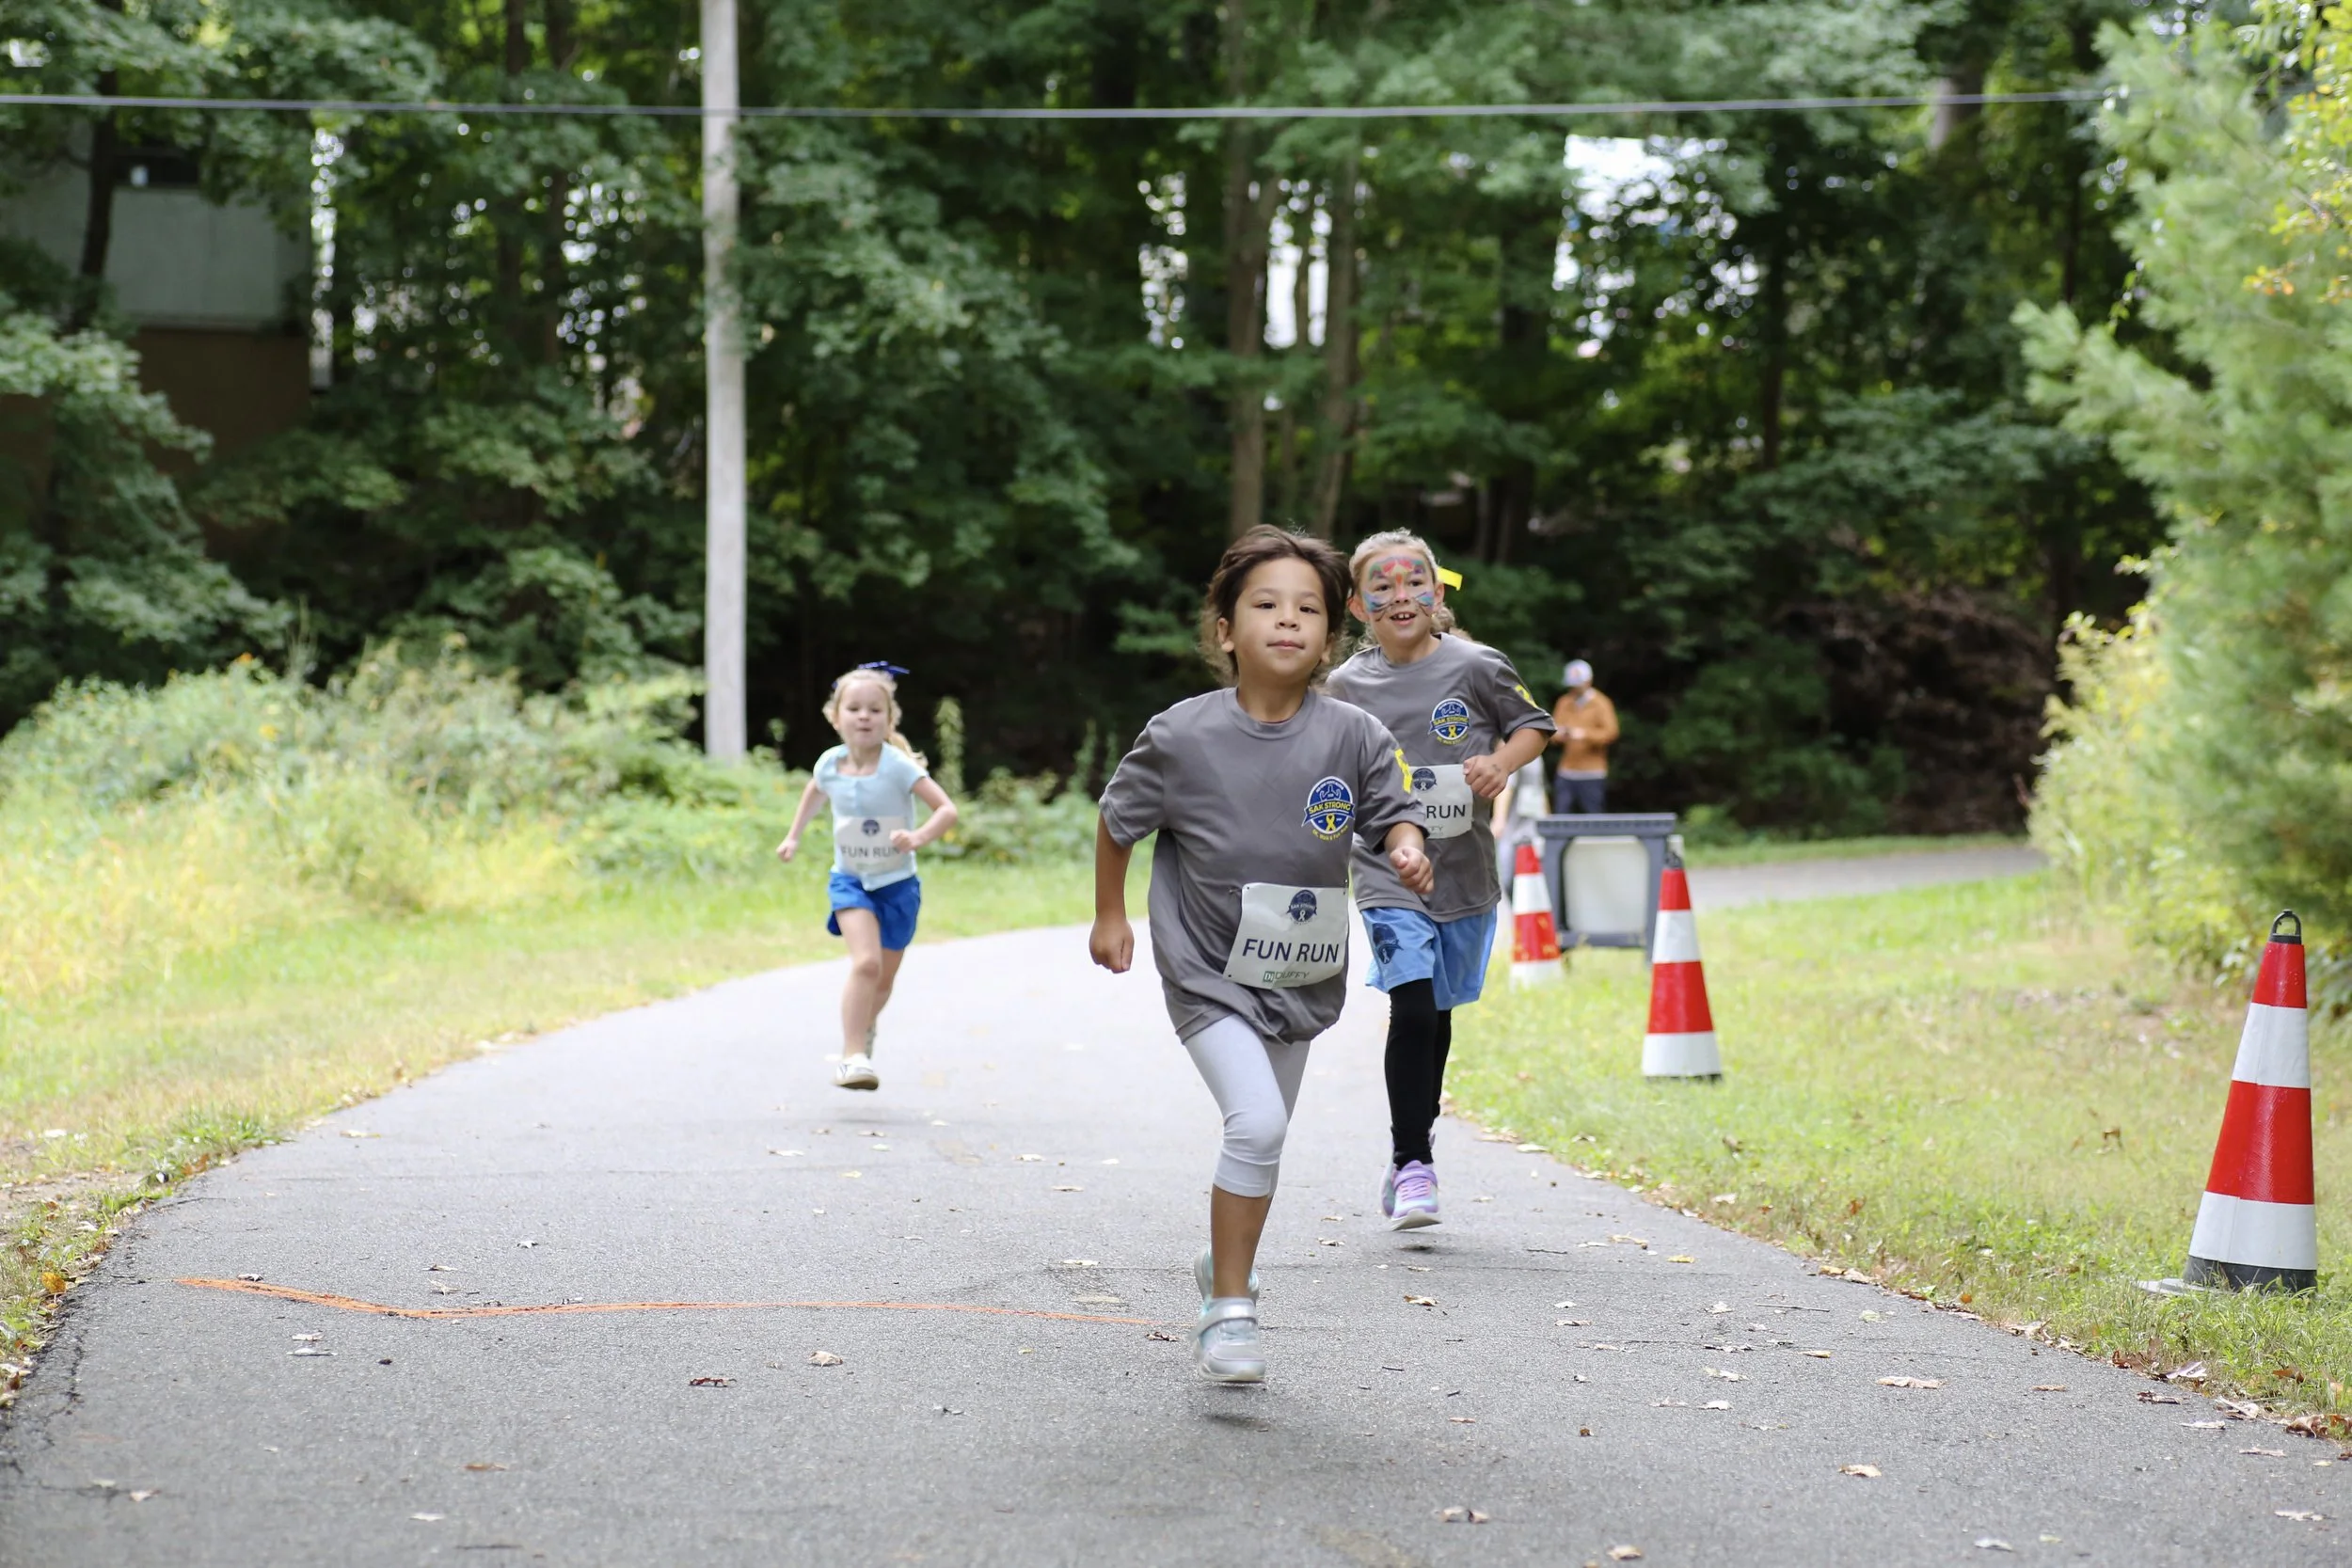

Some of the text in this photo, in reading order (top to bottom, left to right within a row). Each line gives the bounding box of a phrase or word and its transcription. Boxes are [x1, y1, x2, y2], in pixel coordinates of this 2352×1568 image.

[1309, 801, 1352, 815] SAK STRONG
[1426, 804, 1466, 818] RUN
[841, 846, 867, 858] FUN
[1243, 938, 1339, 963] FUN RUN
[1275, 971, 1310, 980] DUFFY
